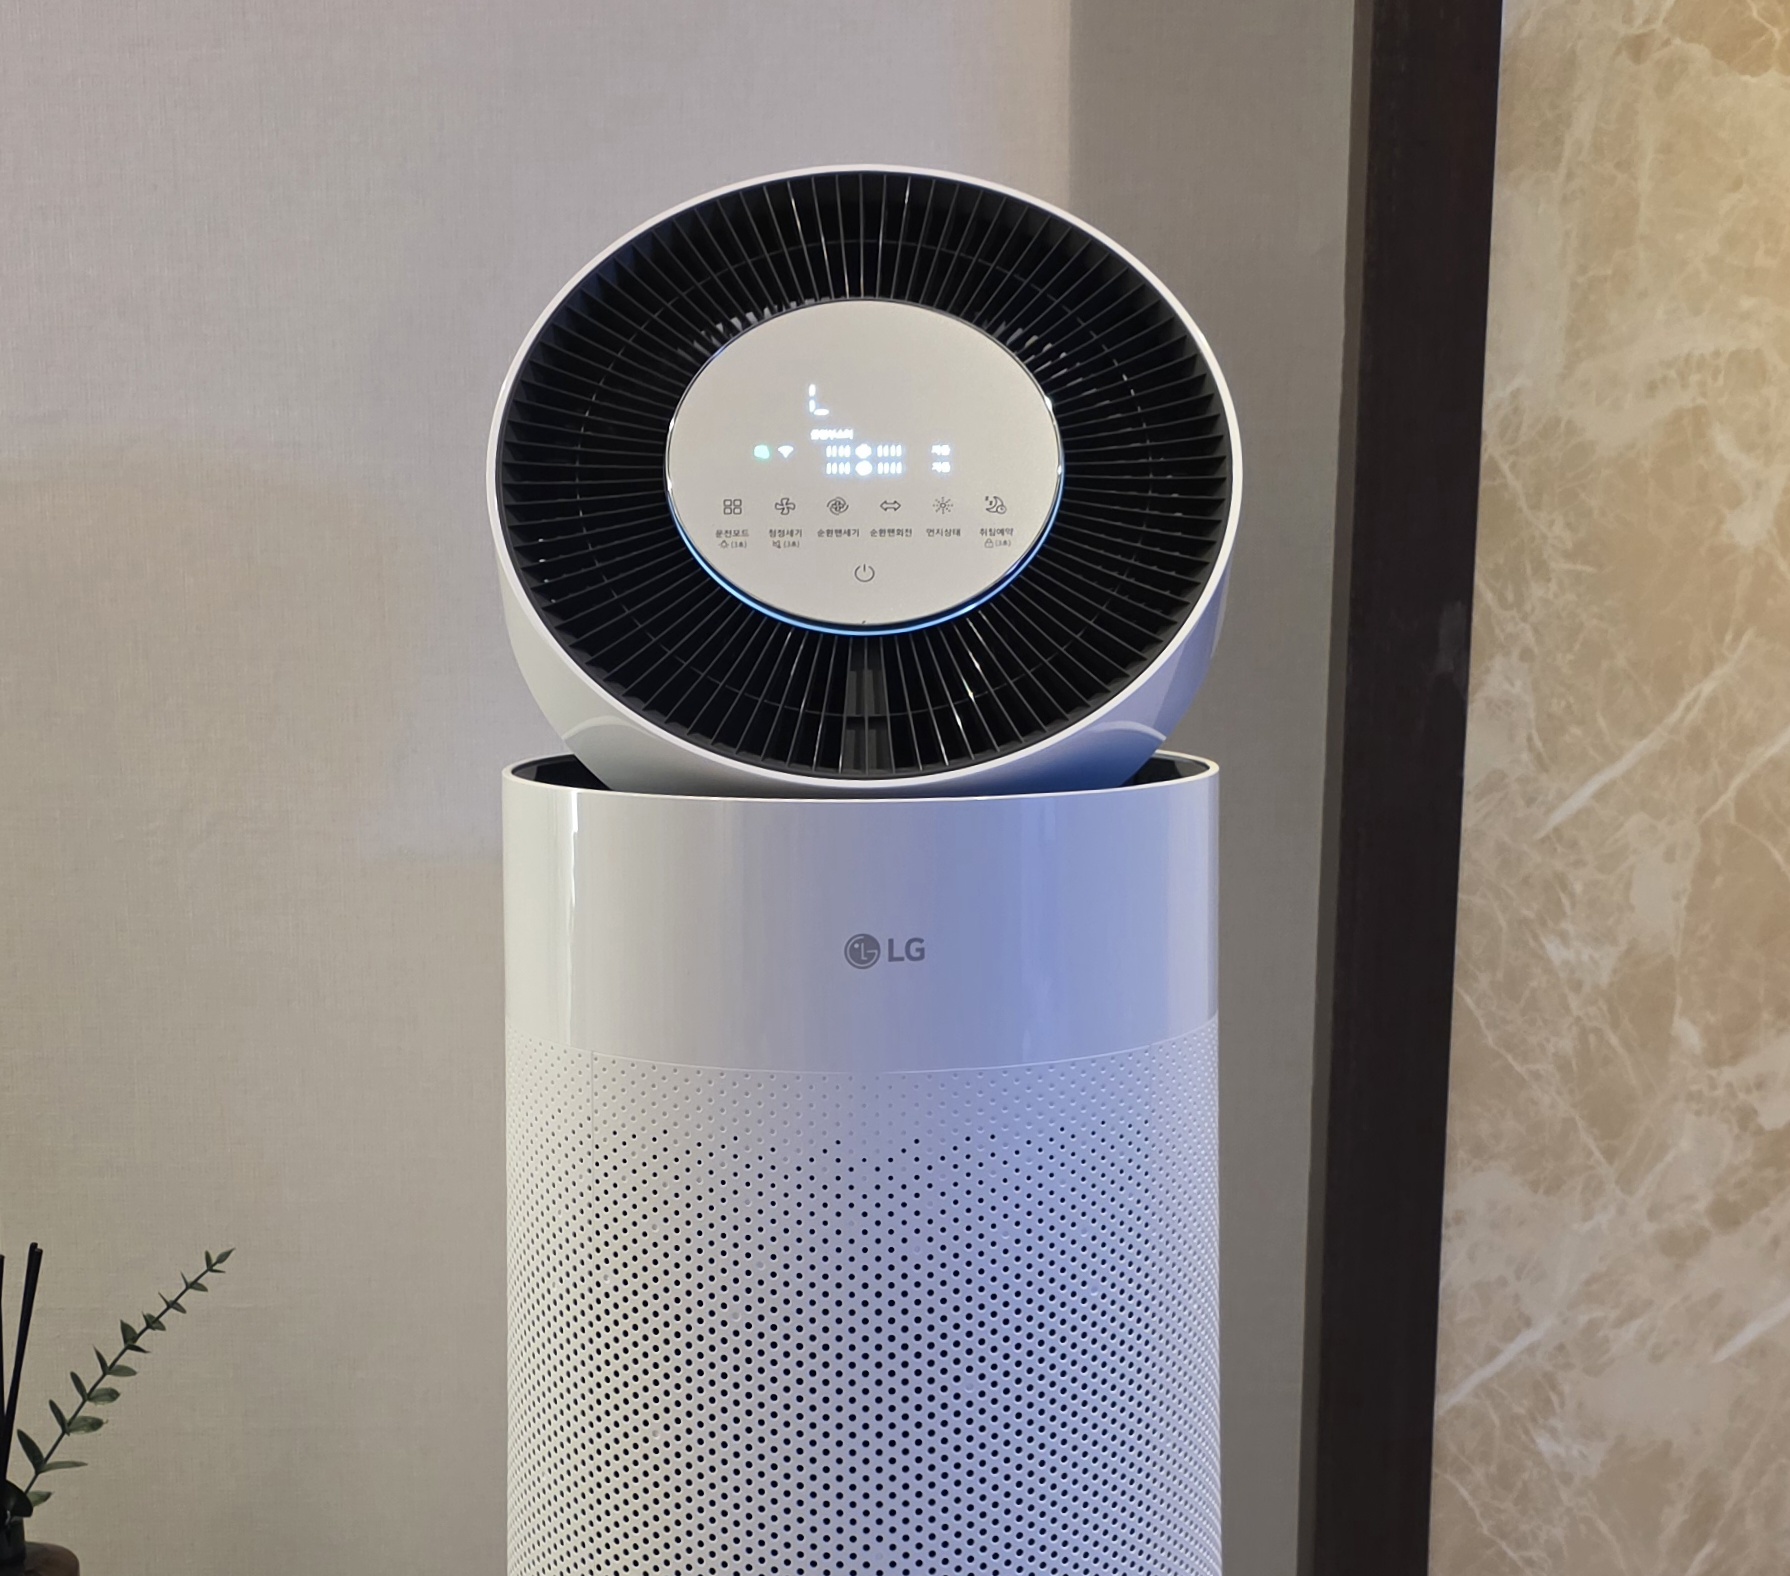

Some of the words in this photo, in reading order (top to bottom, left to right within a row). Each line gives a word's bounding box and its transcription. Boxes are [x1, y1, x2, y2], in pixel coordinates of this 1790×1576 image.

[715, 528, 750, 538] 운전모드
[768, 528, 803, 538] 청정세기
[926, 527, 961, 537] 먼지상태
[979, 527, 1014, 537] 취침예약
[887, 937, 925, 963] LG
